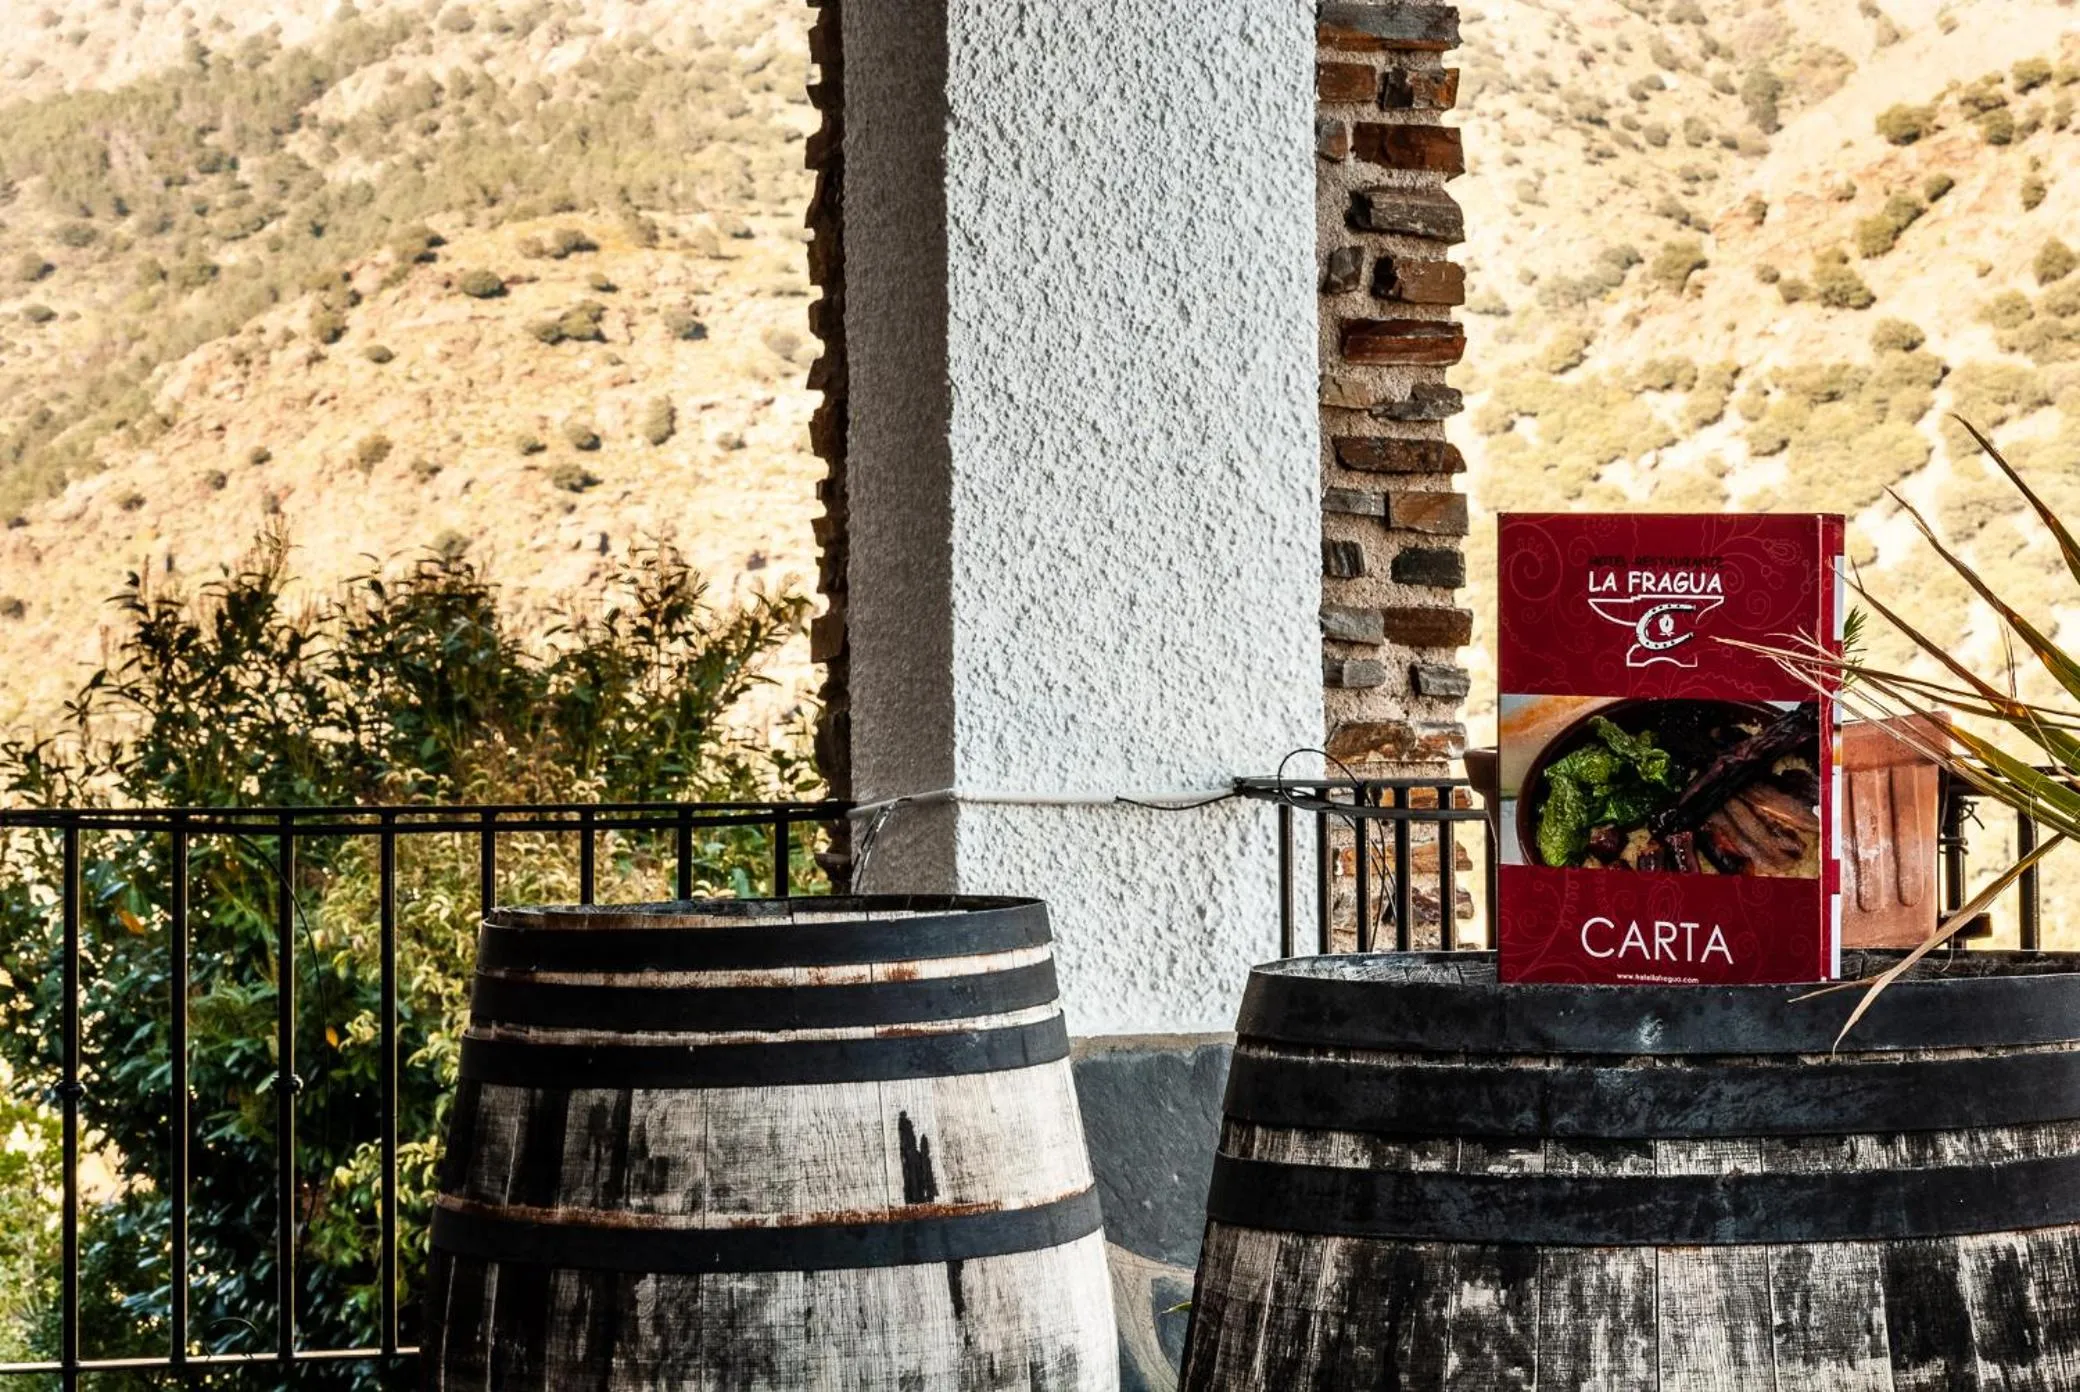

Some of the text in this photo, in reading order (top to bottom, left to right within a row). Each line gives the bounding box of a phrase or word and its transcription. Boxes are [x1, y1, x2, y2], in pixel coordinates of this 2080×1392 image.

[1588, 570, 1723, 593] LA FRAGUA
[1580, 916, 1734, 965] CARTA
